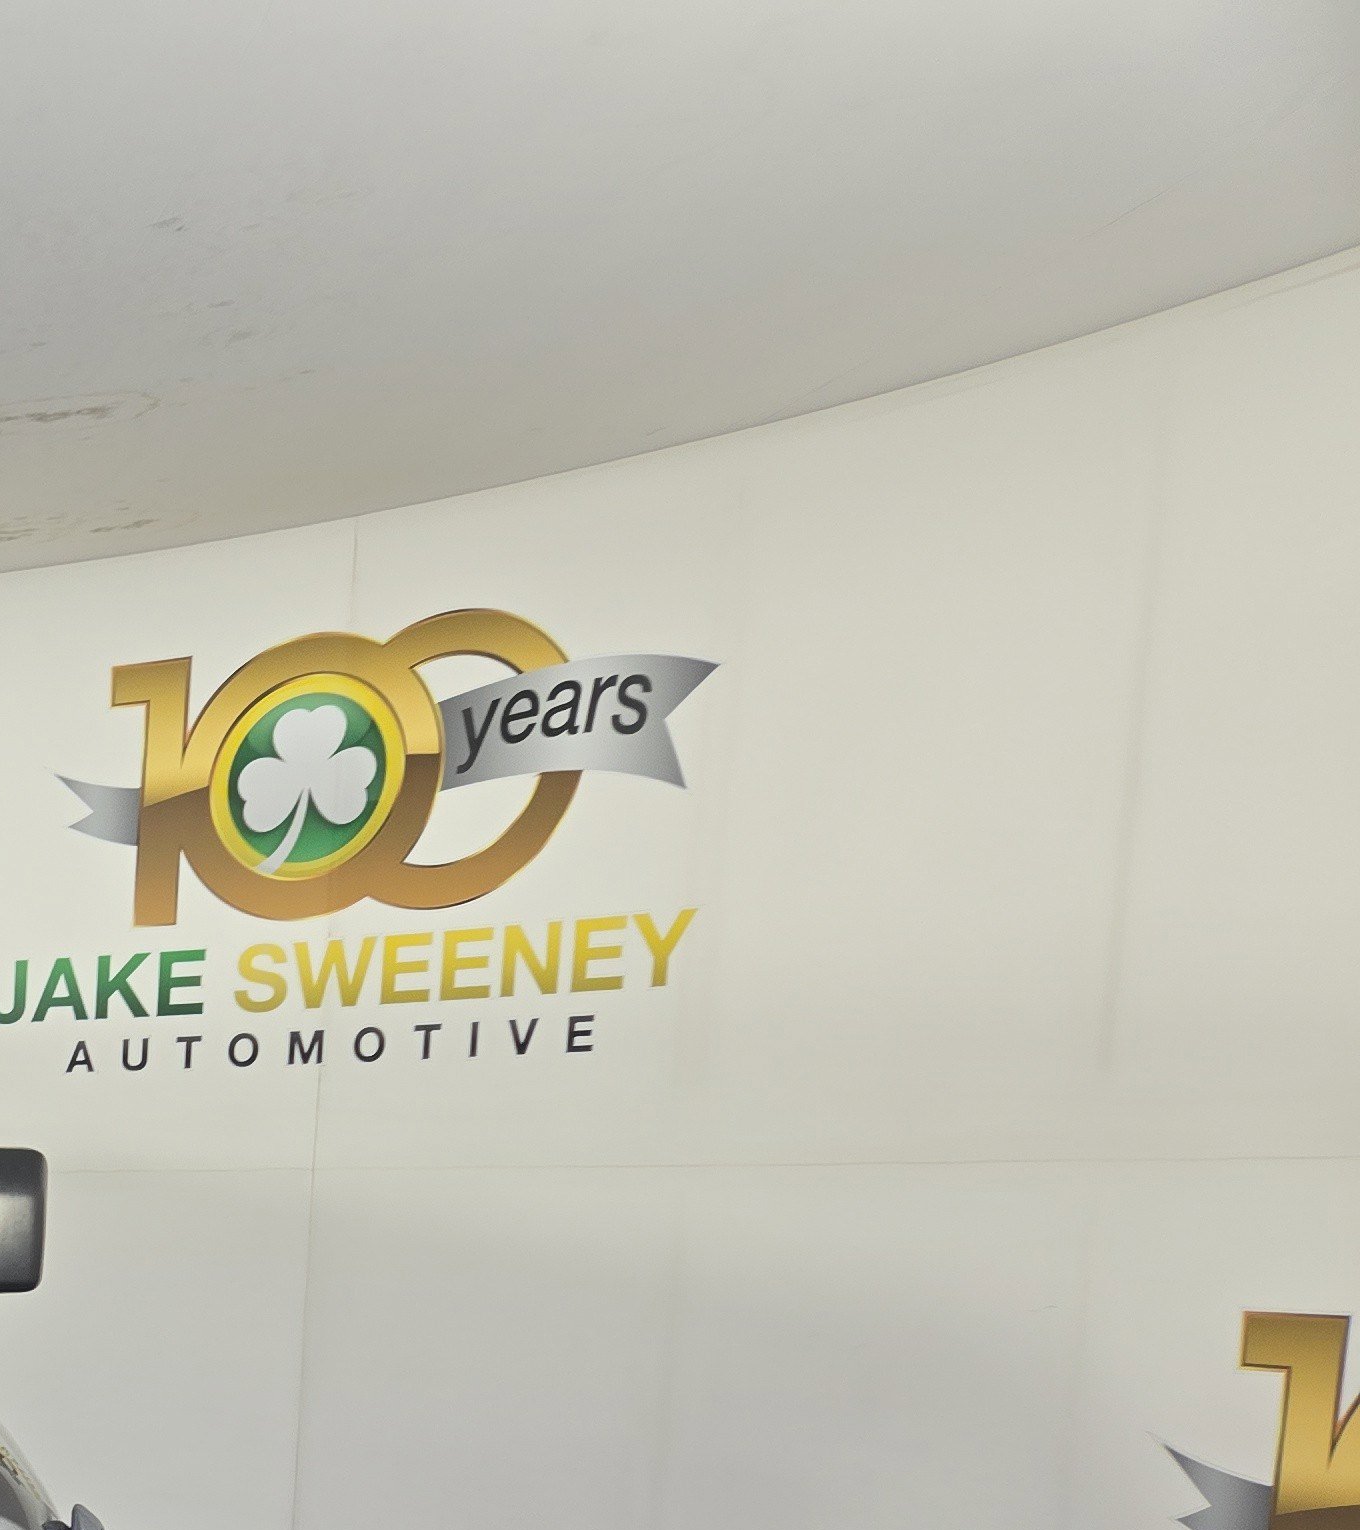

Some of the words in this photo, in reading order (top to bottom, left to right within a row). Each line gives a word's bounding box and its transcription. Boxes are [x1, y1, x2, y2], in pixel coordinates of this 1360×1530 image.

[457, 672, 653, 774] years
[234, 907, 699, 1013] SWEENEY
[66, 1014, 596, 1073] AUTOMOTIVE
